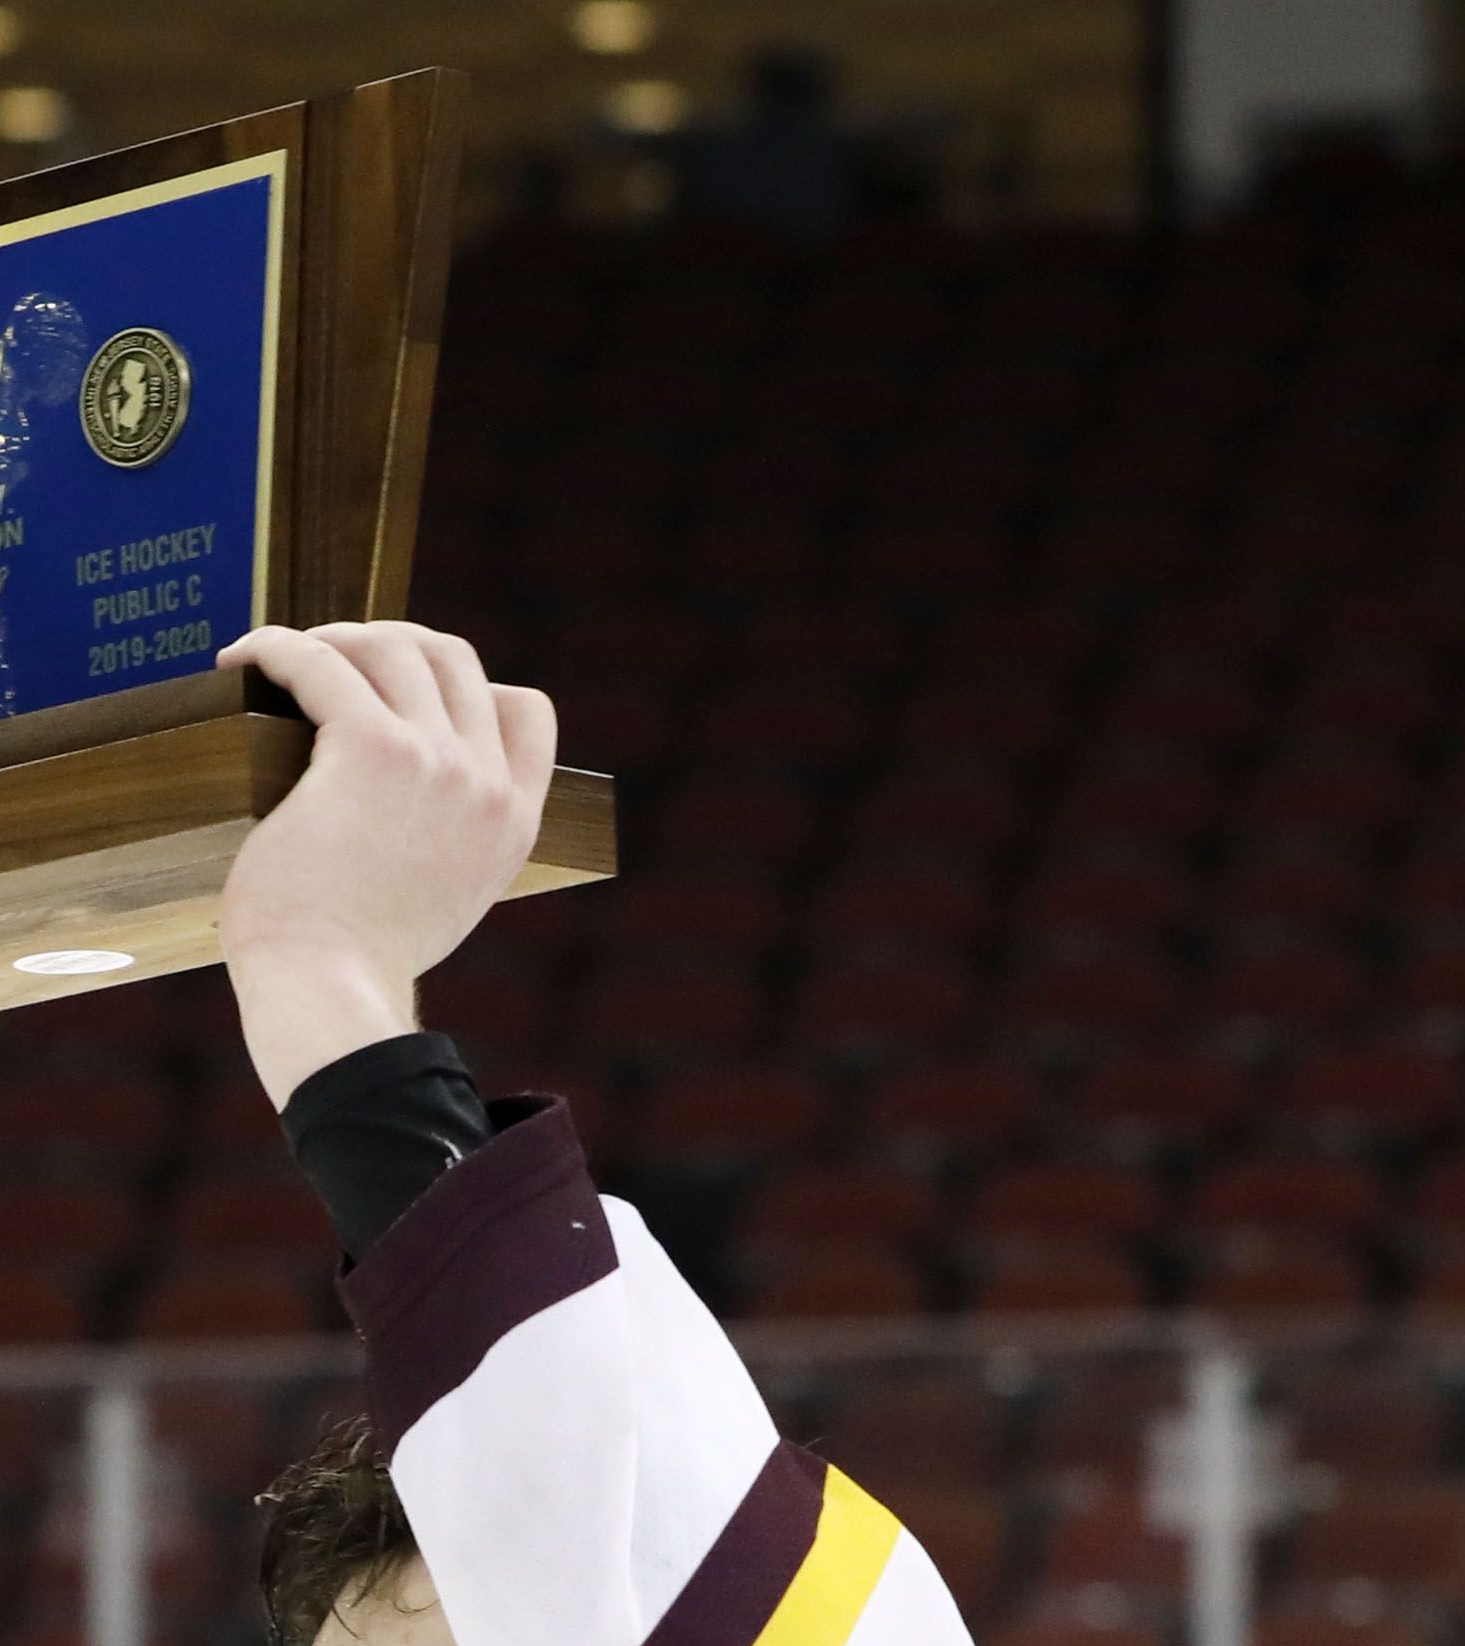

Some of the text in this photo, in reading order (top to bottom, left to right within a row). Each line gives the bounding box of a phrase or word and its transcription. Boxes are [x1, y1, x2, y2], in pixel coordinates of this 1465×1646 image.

[76, 523, 216, 586] ICE HOCKEY
[93, 574, 202, 629] PUBLIC C
[88, 619, 212, 676] 2019-2020
